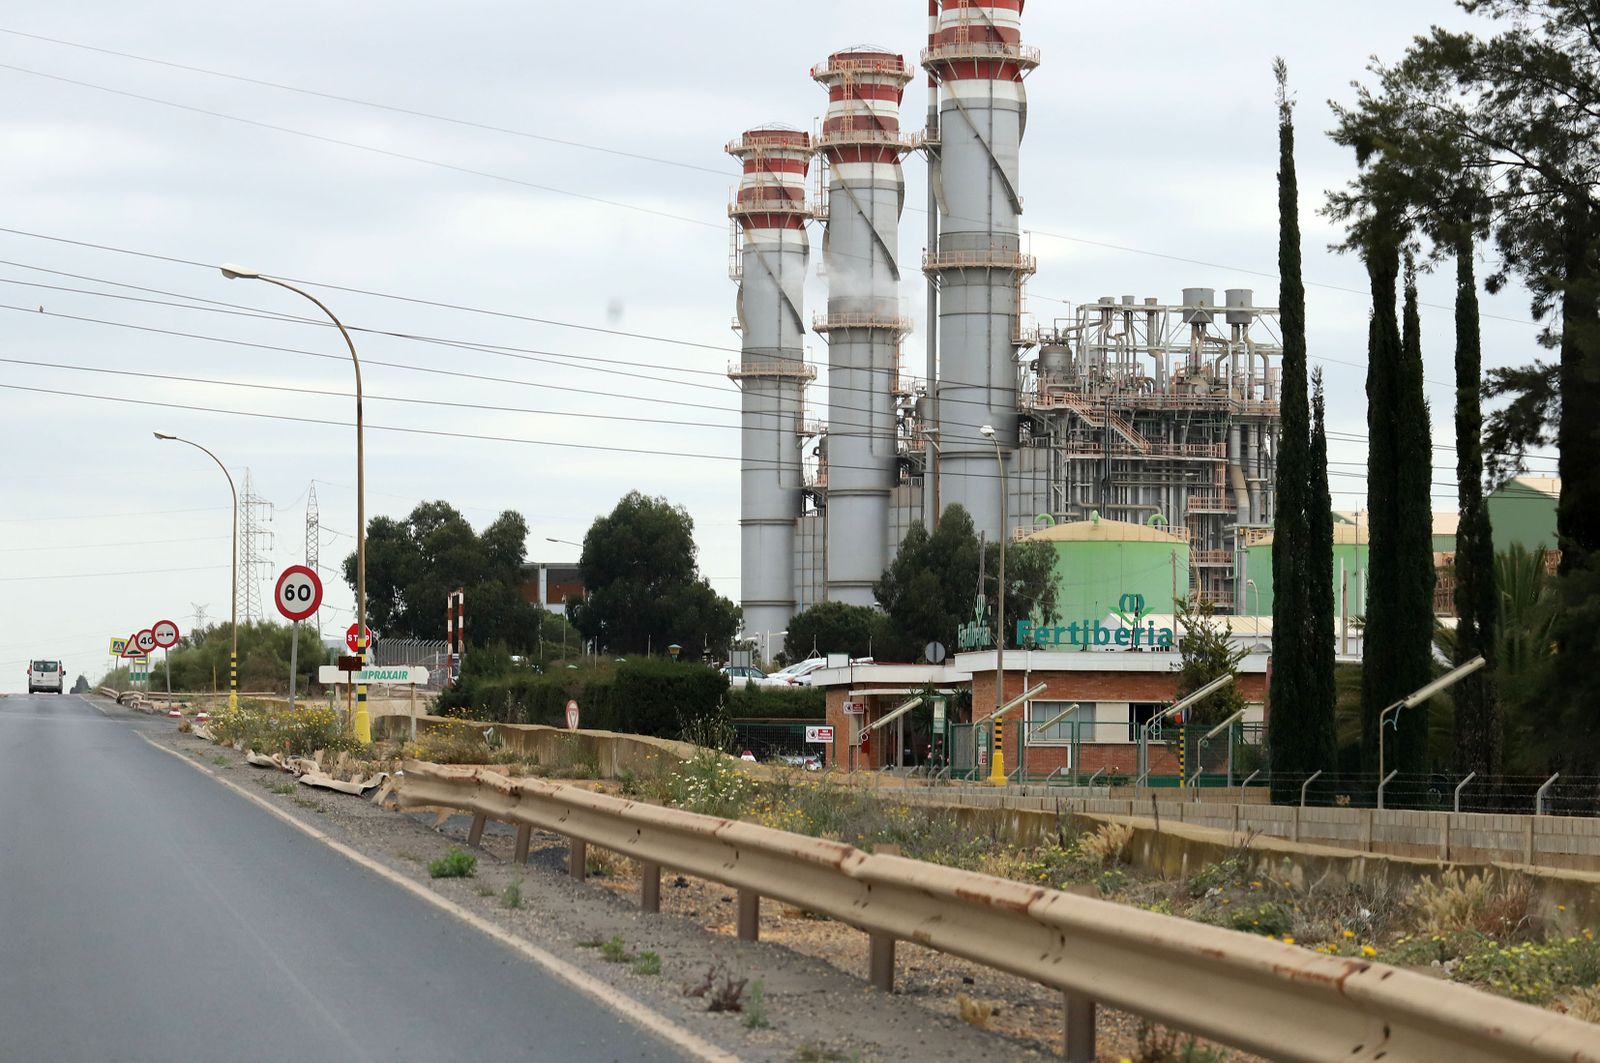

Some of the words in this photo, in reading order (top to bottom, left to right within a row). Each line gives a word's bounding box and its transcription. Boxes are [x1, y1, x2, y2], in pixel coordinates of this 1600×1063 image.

[284, 583, 311, 602] 60
[347, 634, 370, 642] STP
[1016, 619, 1174, 647] Fertiberia
[140, 636, 154, 645] 40
[368, 670, 409, 680] PRAXAIR
